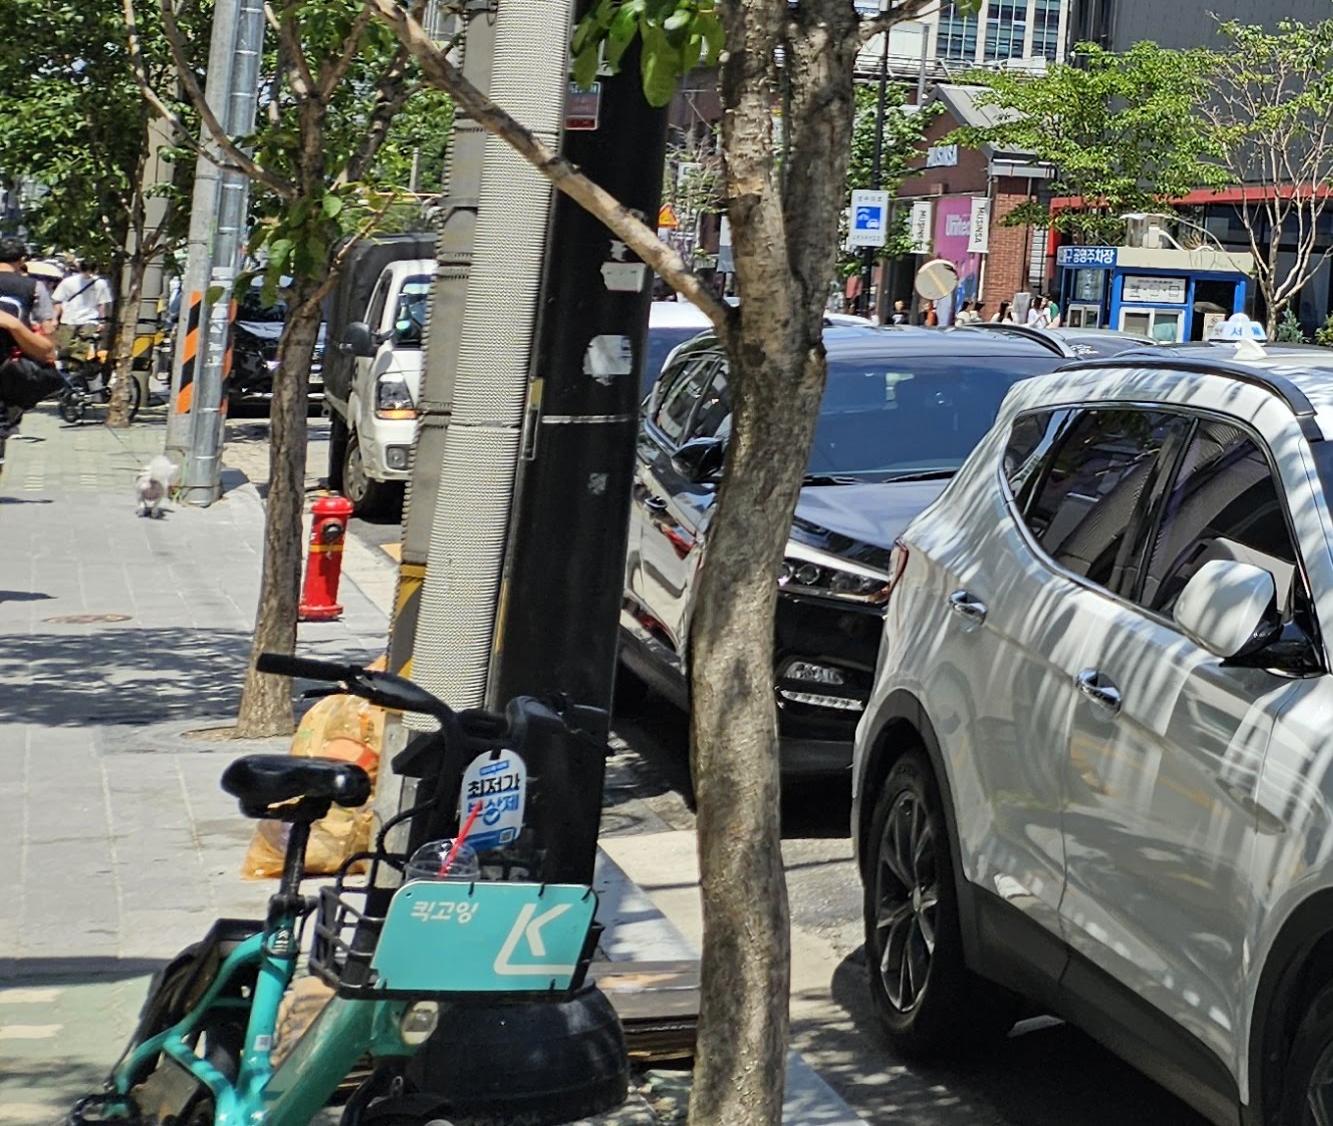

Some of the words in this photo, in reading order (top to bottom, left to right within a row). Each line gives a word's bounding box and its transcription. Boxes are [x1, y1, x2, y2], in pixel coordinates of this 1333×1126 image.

[974, 207, 985, 243] MUSINSA
[1073, 248, 1115, 264] 공영주차장
[467, 773, 520, 799] 최저가
[410, 900, 479, 924] 킥고잉
